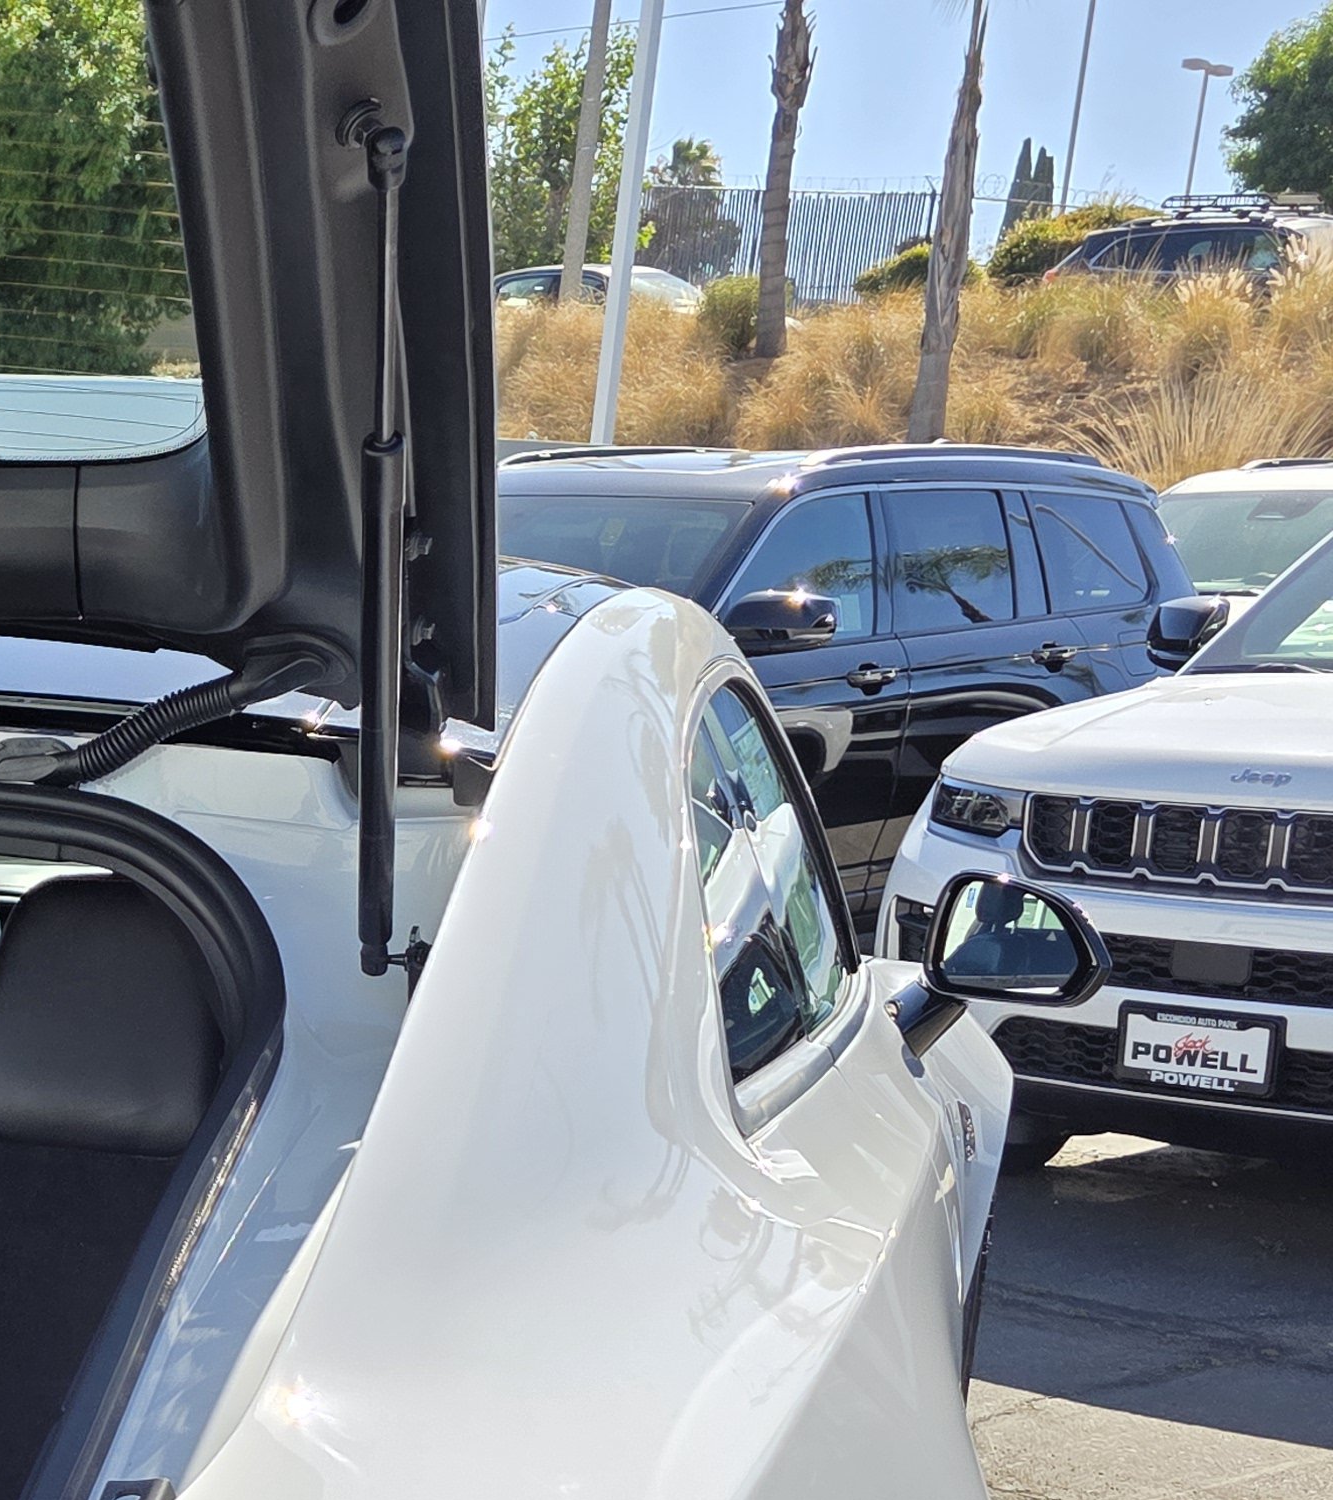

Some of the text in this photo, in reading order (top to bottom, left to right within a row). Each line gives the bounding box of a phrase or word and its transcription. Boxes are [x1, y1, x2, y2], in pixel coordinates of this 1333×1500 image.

[1230, 767, 1292, 787] Jeep
[1156, 1012, 1238, 1030] ESCONDIDO AUTO PARK
[1174, 1032, 1213, 1058] Jack
[1131, 1041, 1257, 1074] POWELL
[1150, 1070, 1235, 1092] POWELL
